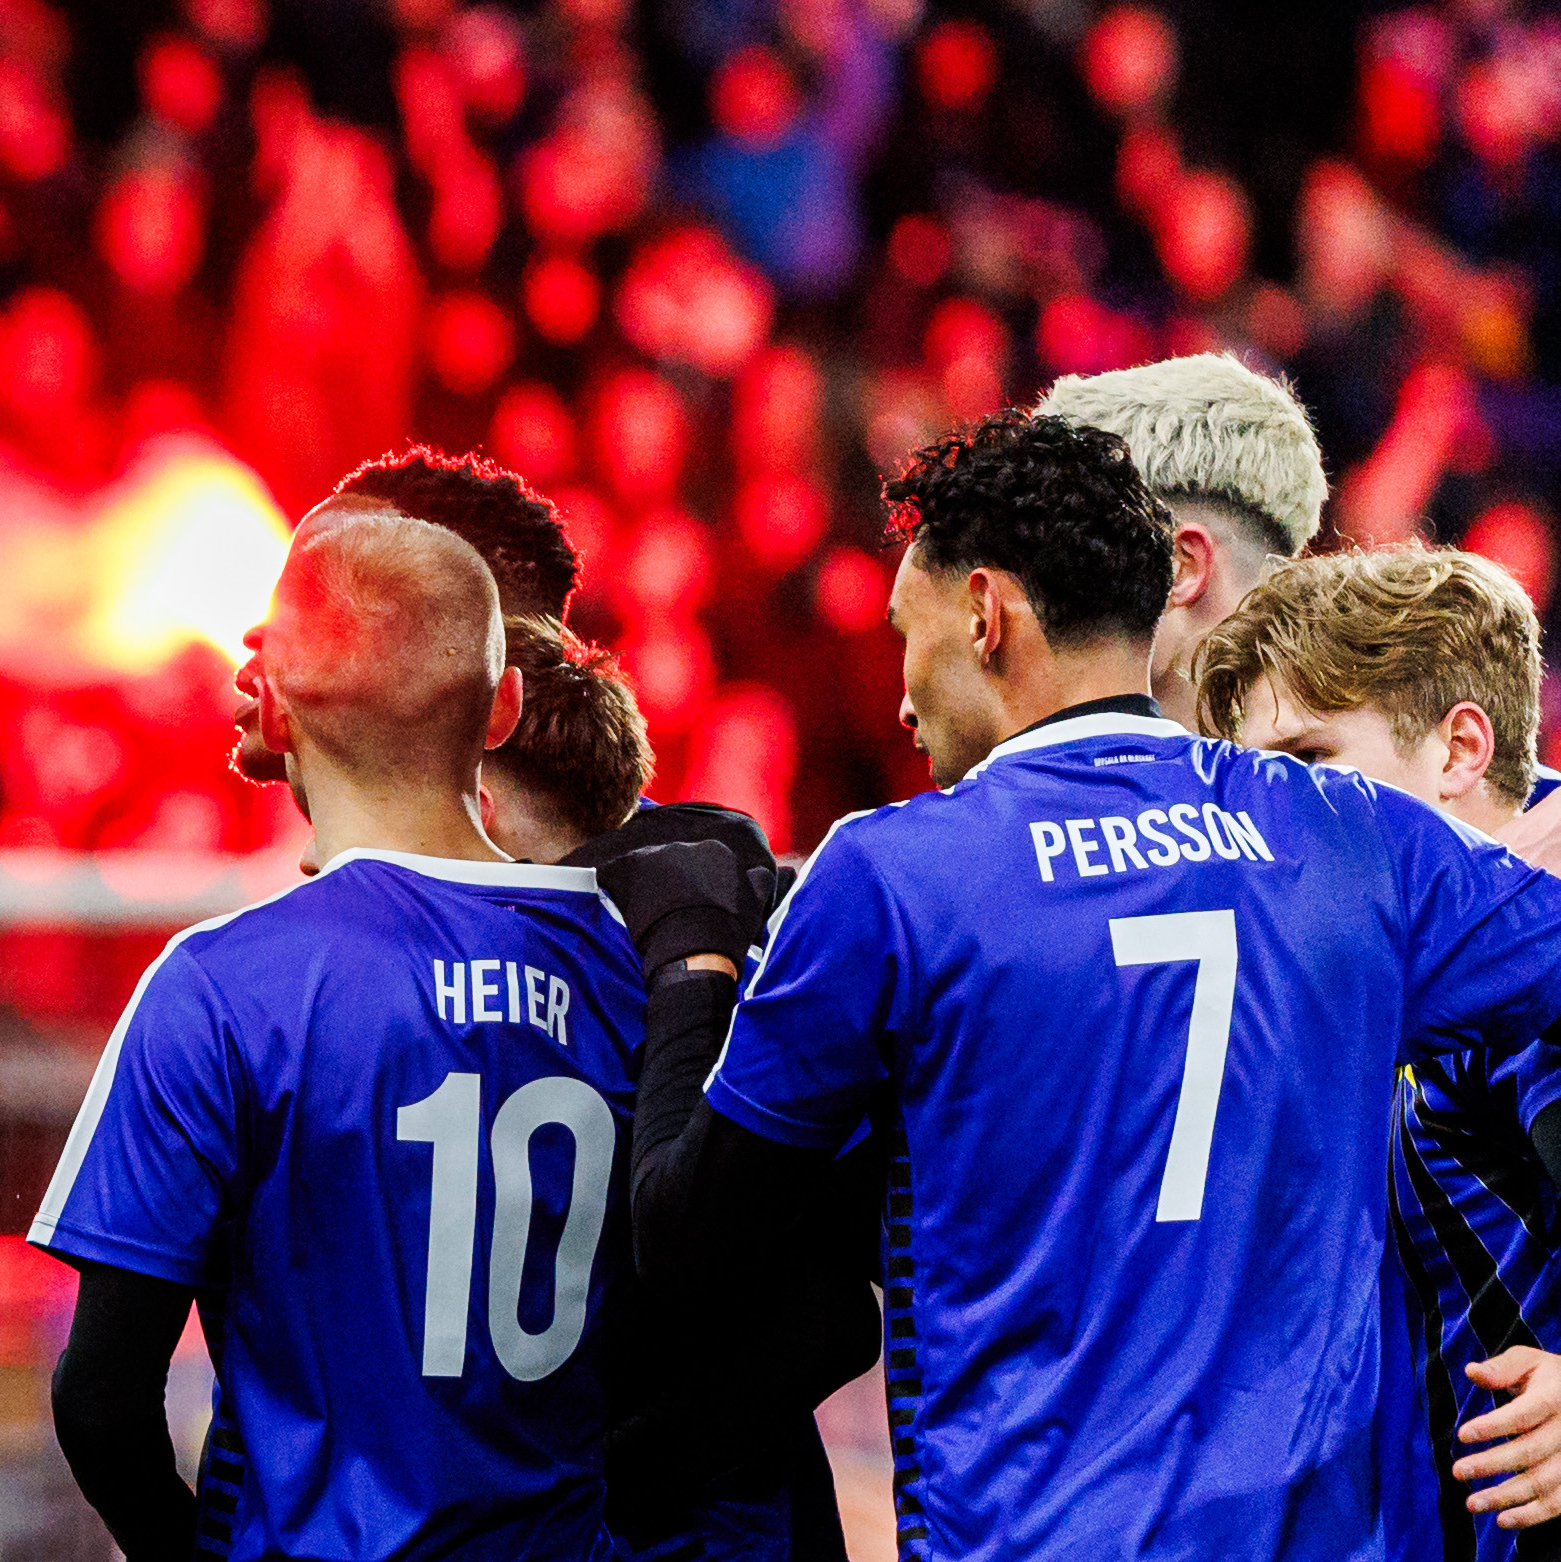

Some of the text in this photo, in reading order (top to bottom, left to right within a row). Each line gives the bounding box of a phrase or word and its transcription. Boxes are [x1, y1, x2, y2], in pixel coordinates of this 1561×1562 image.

[1029, 802, 1275, 882] PERSSON
[433, 958, 572, 1046] HEIER
[1108, 909, 1239, 1224] 7
[396, 1071, 616, 1382] 10
